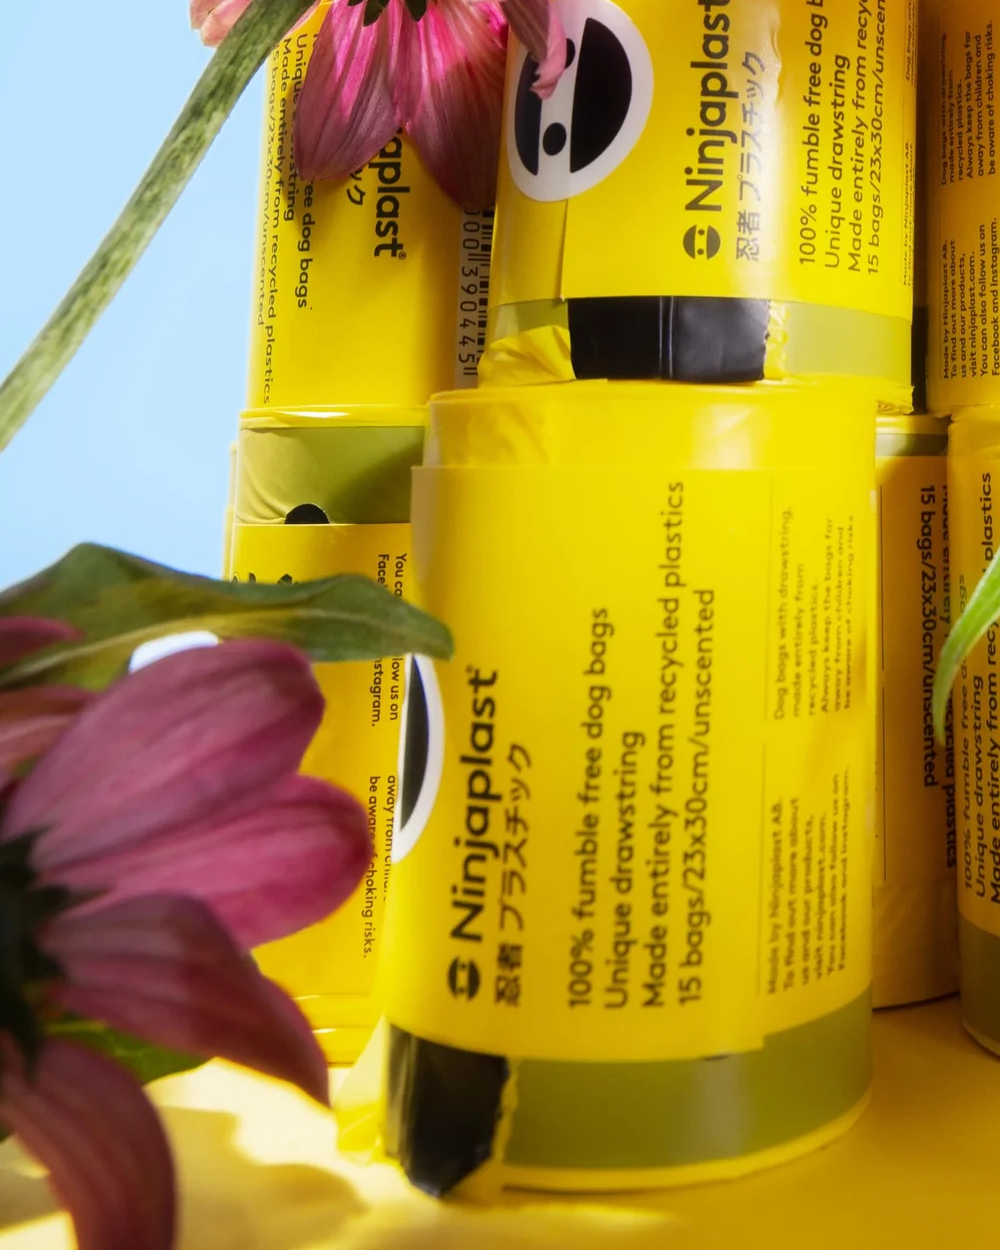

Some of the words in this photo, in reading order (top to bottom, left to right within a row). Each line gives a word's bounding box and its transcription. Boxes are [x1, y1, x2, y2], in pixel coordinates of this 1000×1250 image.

[280, 38, 292, 92] Made
[805, 13, 828, 57] dog
[985, 20, 993, 51] risks.
[803, 62, 821, 107] free
[852, 56, 866, 110] from
[986, 53, 995, 101] choking
[274, 98, 288, 172] entirely
[737, 52, 765, 202] プラスチック
[828, 54, 850, 180] drawstring
[986, 104, 994, 117] of
[800, 113, 820, 195] fumble
[850, 116, 868, 203] entirely
[987, 164, 996, 175] be
[272, 179, 284, 228] from
[298, 213, 316, 252] dog
[799, 204, 817, 265] 100%
[825, 187, 845, 268] Unique
[736, 210, 760, 262] 忍者
[848, 209, 863, 272] Made
[868, 254, 879, 276] 15
[989, 218, 1000, 286] Instagram.
[268, 235, 279, 318] recycled
[295, 258, 313, 309] bags
[968, 251, 978, 348] ninjaplast.com.
[990, 289, 998, 313] and
[457, 265, 478, 363] 390445
[264, 325, 276, 404] plastics
[969, 352, 977, 377] visit
[990, 316, 1000, 377] Facebook
[920, 485, 935, 505] 15
[981, 472, 997, 562] plastics
[657, 481, 688, 588] plastics
[583, 608, 614, 676] bags
[655, 598, 684, 713] recycled
[389, 703, 398, 720] on
[390, 685, 400, 700] us
[581, 685, 612, 741] dog
[959, 686, 969, 730] free
[985, 673, 999, 732] from
[649, 723, 677, 795] from
[969, 676, 984, 807] drawstring
[369, 776, 381, 792] be
[576, 748, 602, 803] free
[679, 588, 714, 967] bags/23x30cm/unscented
[960, 738, 971, 822] fumble
[609, 729, 645, 890] drawstring
[571, 813, 599, 921] fumble
[645, 806, 678, 915] entirely
[961, 827, 972, 890] 100%
[974, 813, 988, 898] Unique
[569, 930, 595, 1010] 100%
[604, 903, 638, 1009] Unique
[643, 925, 668, 1008] Made
[676, 976, 701, 1004] 15
